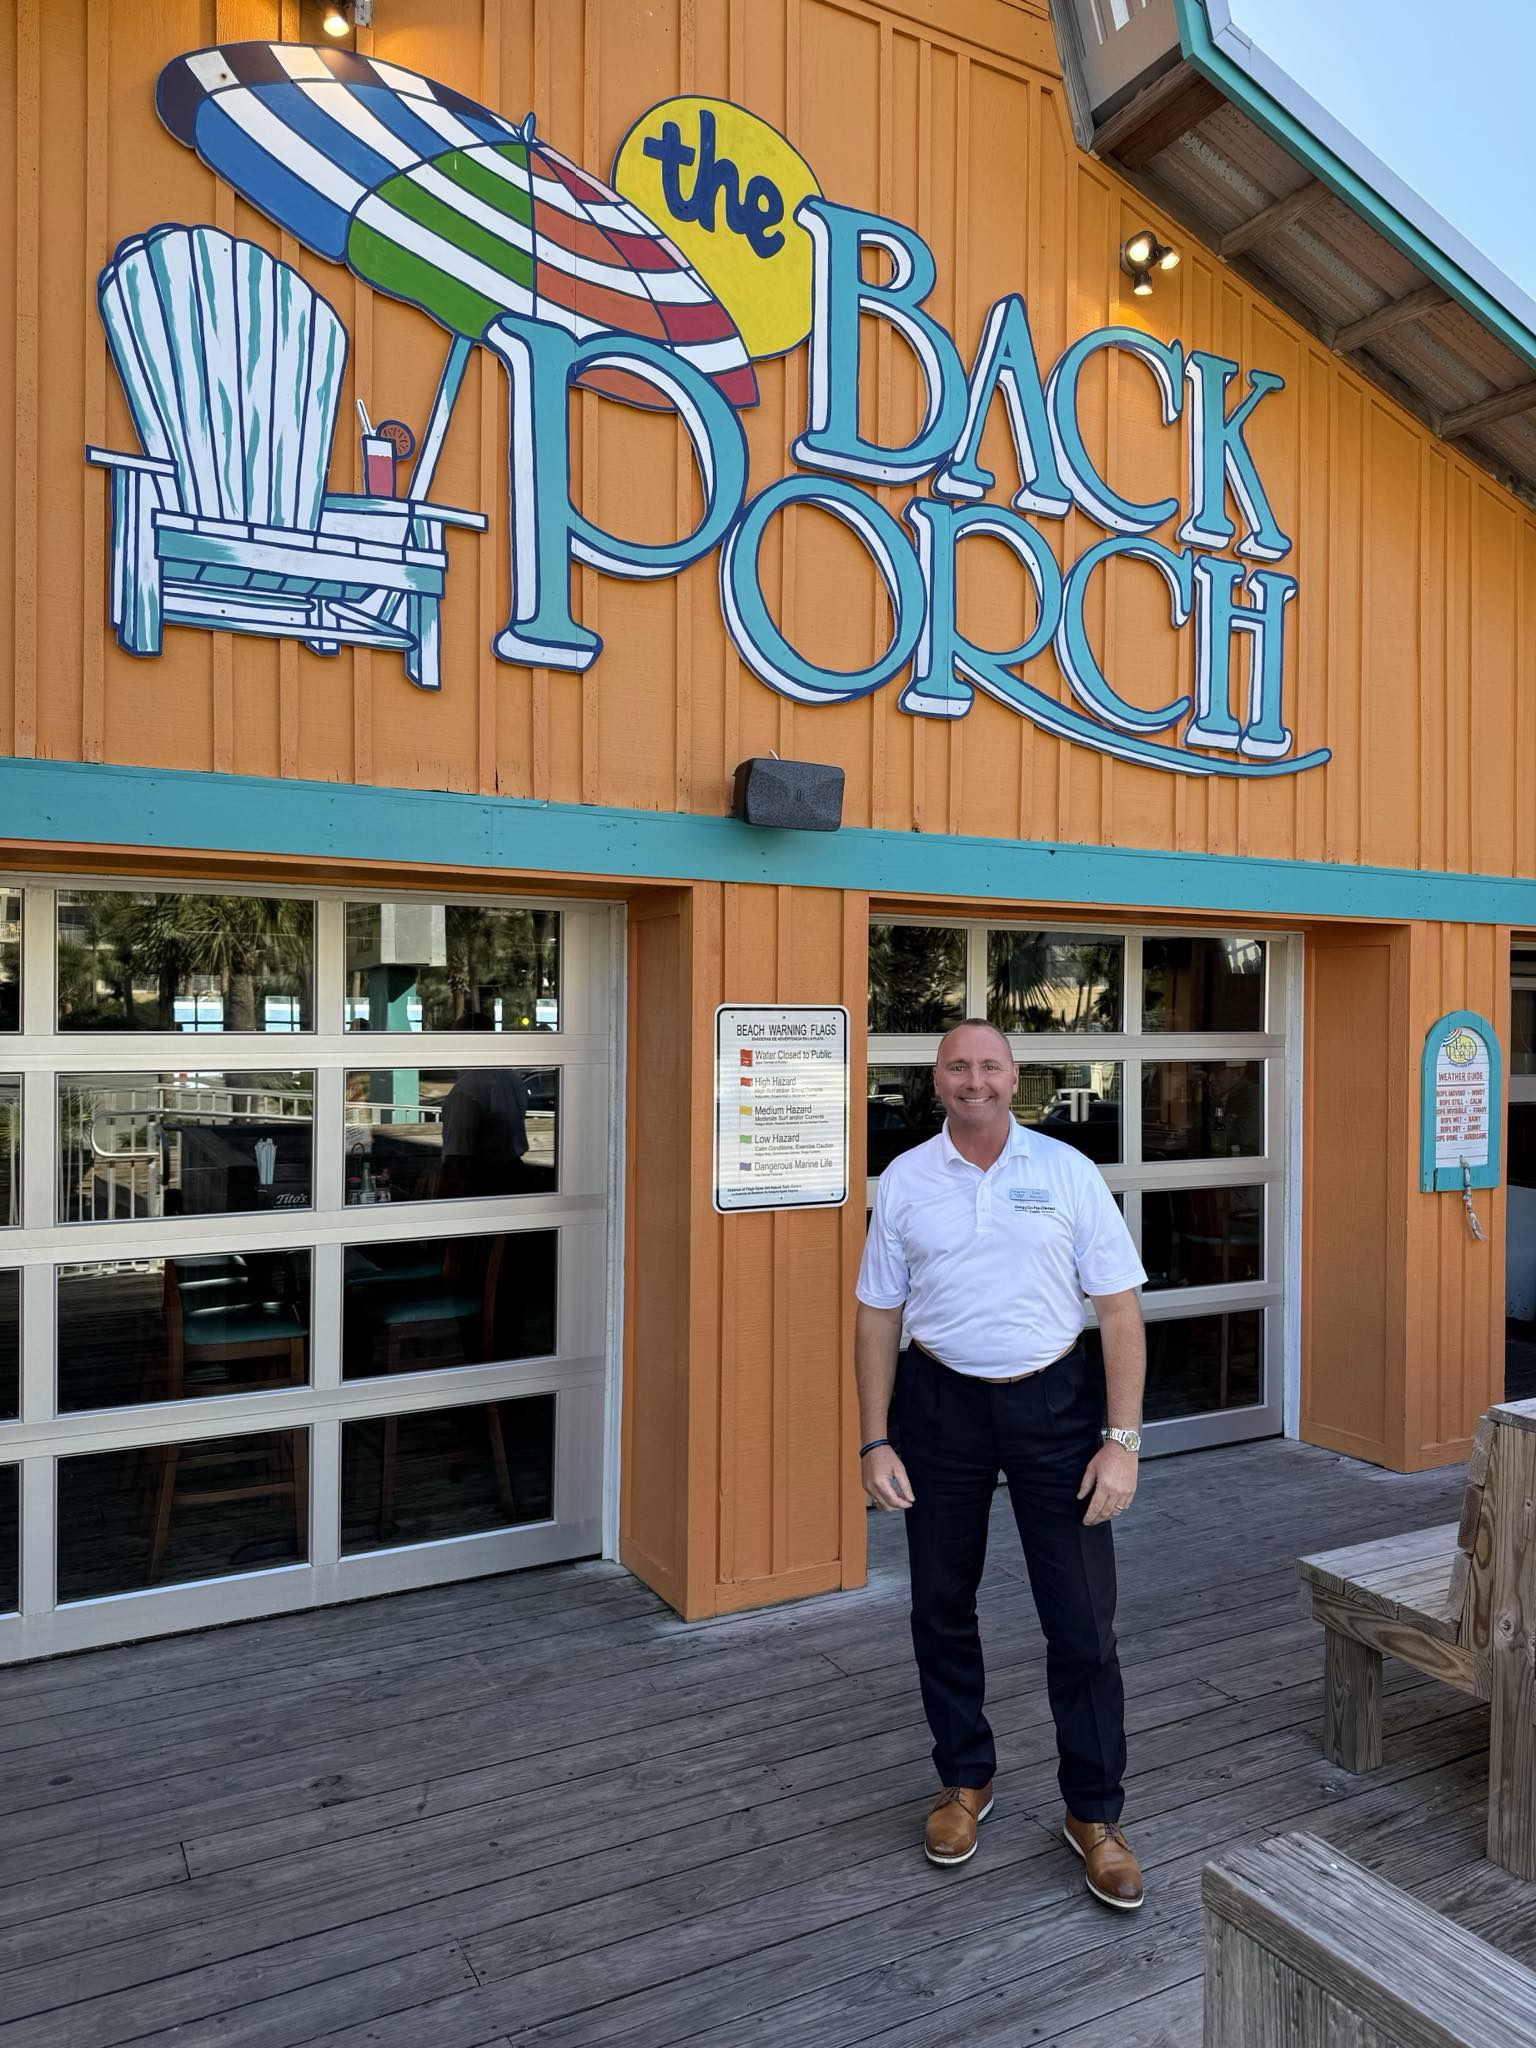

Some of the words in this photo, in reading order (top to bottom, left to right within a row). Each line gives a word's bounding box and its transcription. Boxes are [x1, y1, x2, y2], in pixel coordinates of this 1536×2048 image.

[643, 109, 785, 259] the
[791, 194, 1293, 563] BACK
[482, 311, 1332, 778] PORCH
[736, 1024, 765, 1036] BEACH
[769, 1024, 807, 1036] WARNING
[810, 1024, 837, 1036] FLAGS
[755, 1050, 776, 1060] Water
[778, 1049, 801, 1059] Closed
[802, 1050, 810, 1059] to
[811, 1049, 832, 1059] Public
[755, 1077, 770, 1088] High
[772, 1076, 797, 1086] Hazard
[1438, 1072, 1466, 1081] WEATHER
[1466, 1071, 1484, 1080] GUIDE
[755, 1105, 784, 1115] Medium
[786, 1105, 812, 1114] Hazard
[754, 1134, 771, 1144] Low
[772, 1133, 800, 1143] Hazard
[1463, 1132, 1488, 1140] HURRICANE
[754, 1161, 793, 1173] Dangerous
[794, 1160, 819, 1169] Marine
[820, 1158, 833, 1168] Life
[276, 1193, 308, 1205] Tito's
